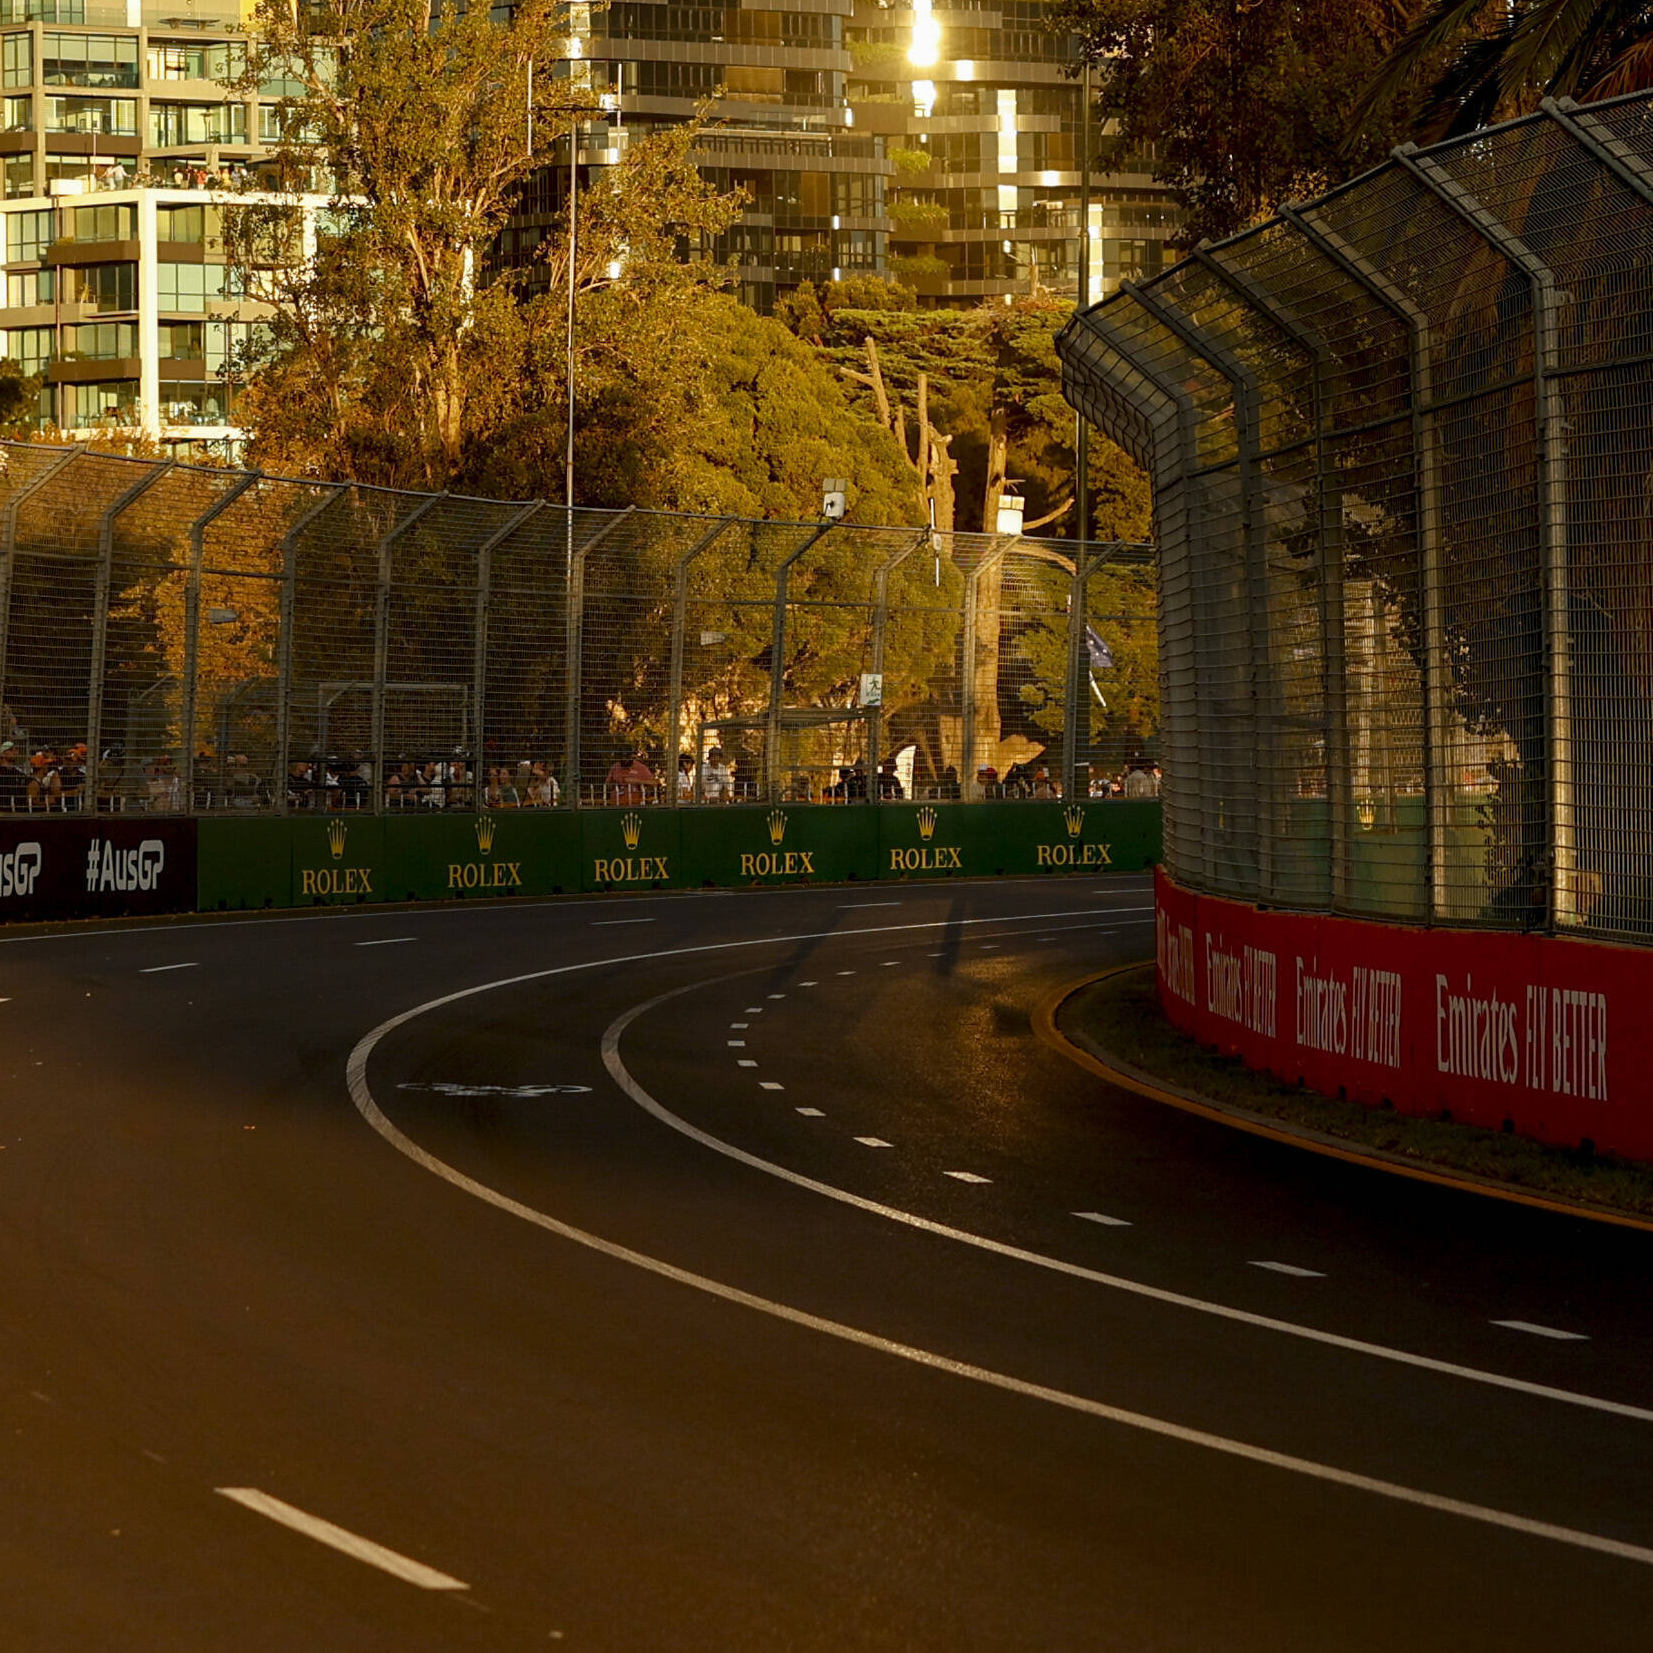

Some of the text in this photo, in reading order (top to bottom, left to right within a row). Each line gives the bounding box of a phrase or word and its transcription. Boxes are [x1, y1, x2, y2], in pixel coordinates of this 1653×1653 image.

[87, 838, 164, 892] #AusGP
[740, 850, 814, 876] ROLEX
[890, 846, 962, 870] ROLEX
[1036, 843, 1111, 867] ROLEX
[302, 869, 371, 895] ROLEX
[448, 862, 521, 887] ROLEX
[594, 856, 668, 882] ROLEX
[1206, 933, 1242, 1024] Emirates
[1296, 954, 1347, 1055] Emirates
[1351, 966, 1368, 1060] FLY
[1368, 968, 1402, 1069] BETTER
[1435, 973, 1607, 1102] Emirates FLY BETTER
